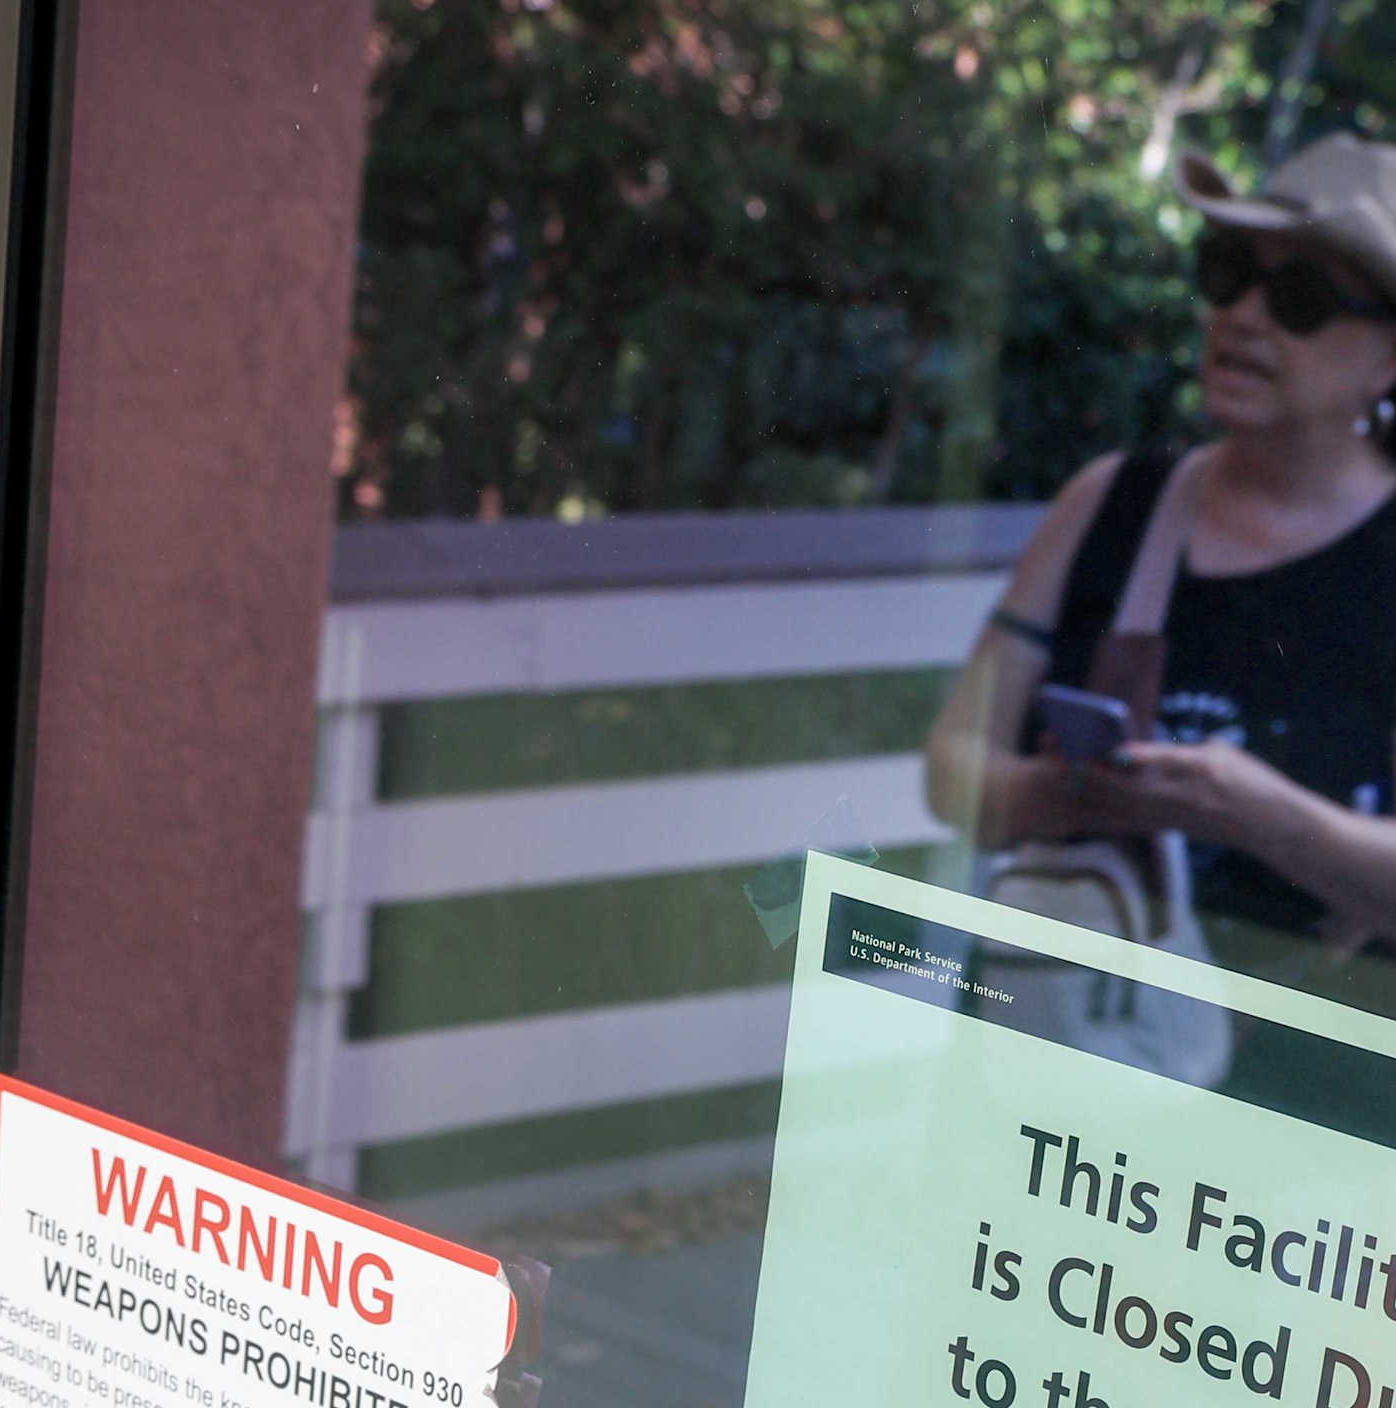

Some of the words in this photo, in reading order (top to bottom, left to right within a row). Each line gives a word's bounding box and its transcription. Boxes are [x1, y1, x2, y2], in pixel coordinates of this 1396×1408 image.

[850, 945, 870, 961] U.S.
[873, 952, 936, 982] Department
[938, 973, 951, 985] of
[952, 976, 971, 991] the
[973, 982, 1015, 1004] Interior
[852, 929, 896, 952] National
[898, 943, 922, 960] Park
[924, 952, 963, 972] Service
[1019, 1123, 1160, 1234] This
[91, 1147, 394, 1326] WARNING
[25, 1208, 68, 1247] Title
[75, 1230, 102, 1263] 18,
[110, 1243, 177, 1292] United
[184, 1274, 251, 1322] States
[258, 1304, 320, 1354] Code,
[329, 1332, 415, 1390] Section
[422, 1371, 463, 1408] 930
[43, 1256, 208, 1356] WEAPONS
[971, 1221, 1023, 1302] is
[1047, 1257, 1292, 1401] Closed
[66, 1325, 97, 1357] law
[101, 1346, 179, 1393] prohibits
[185, 1377, 214, 1408] the
[66, 1362, 83, 1387] to
[87, 1369, 110, 1399] be
